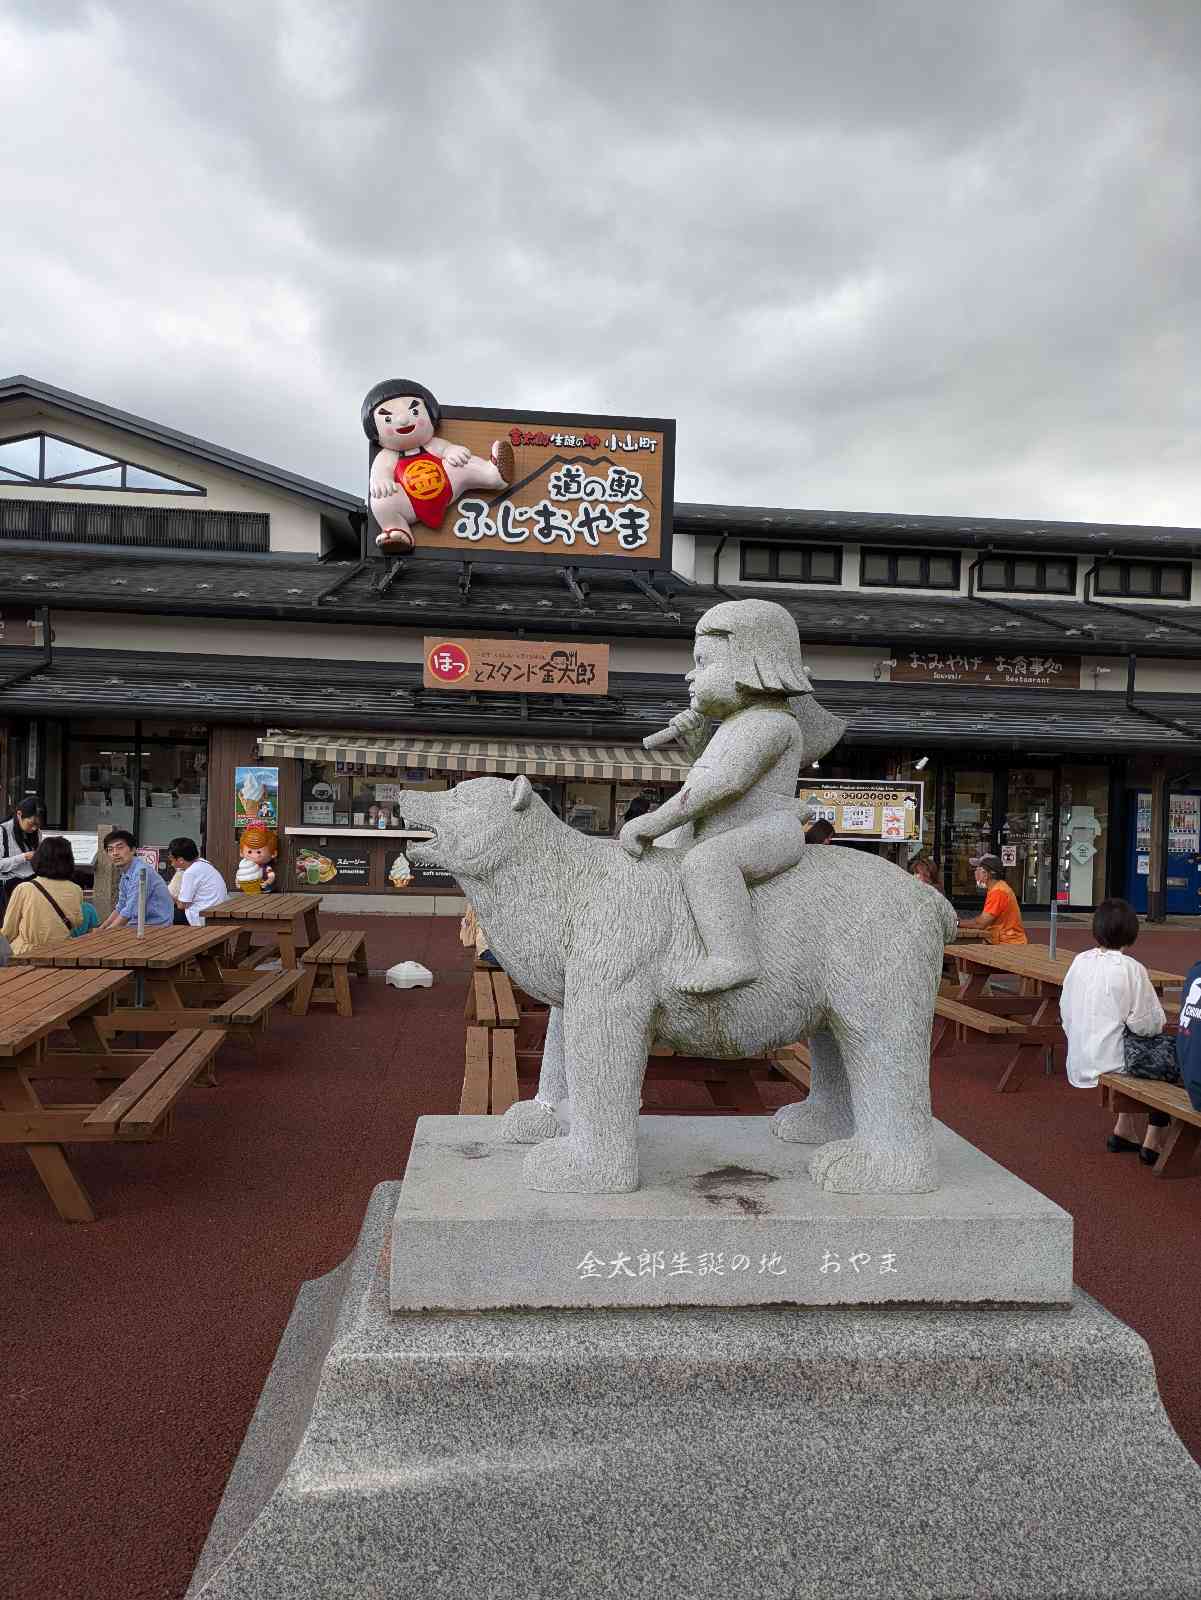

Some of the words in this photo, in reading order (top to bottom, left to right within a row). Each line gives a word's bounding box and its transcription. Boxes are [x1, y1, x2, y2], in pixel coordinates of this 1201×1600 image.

[604, 432, 657, 453] 小山町
[550, 466, 641, 502] 道の駅
[454, 499, 650, 549] ふじおやま
[909, 651, 983, 672] おみやげ
[994, 655, 1063, 674] お食事処
[576, 1249, 788, 1279] 金太郎生誕の地
[818, 1249, 899, 1275] おやま
